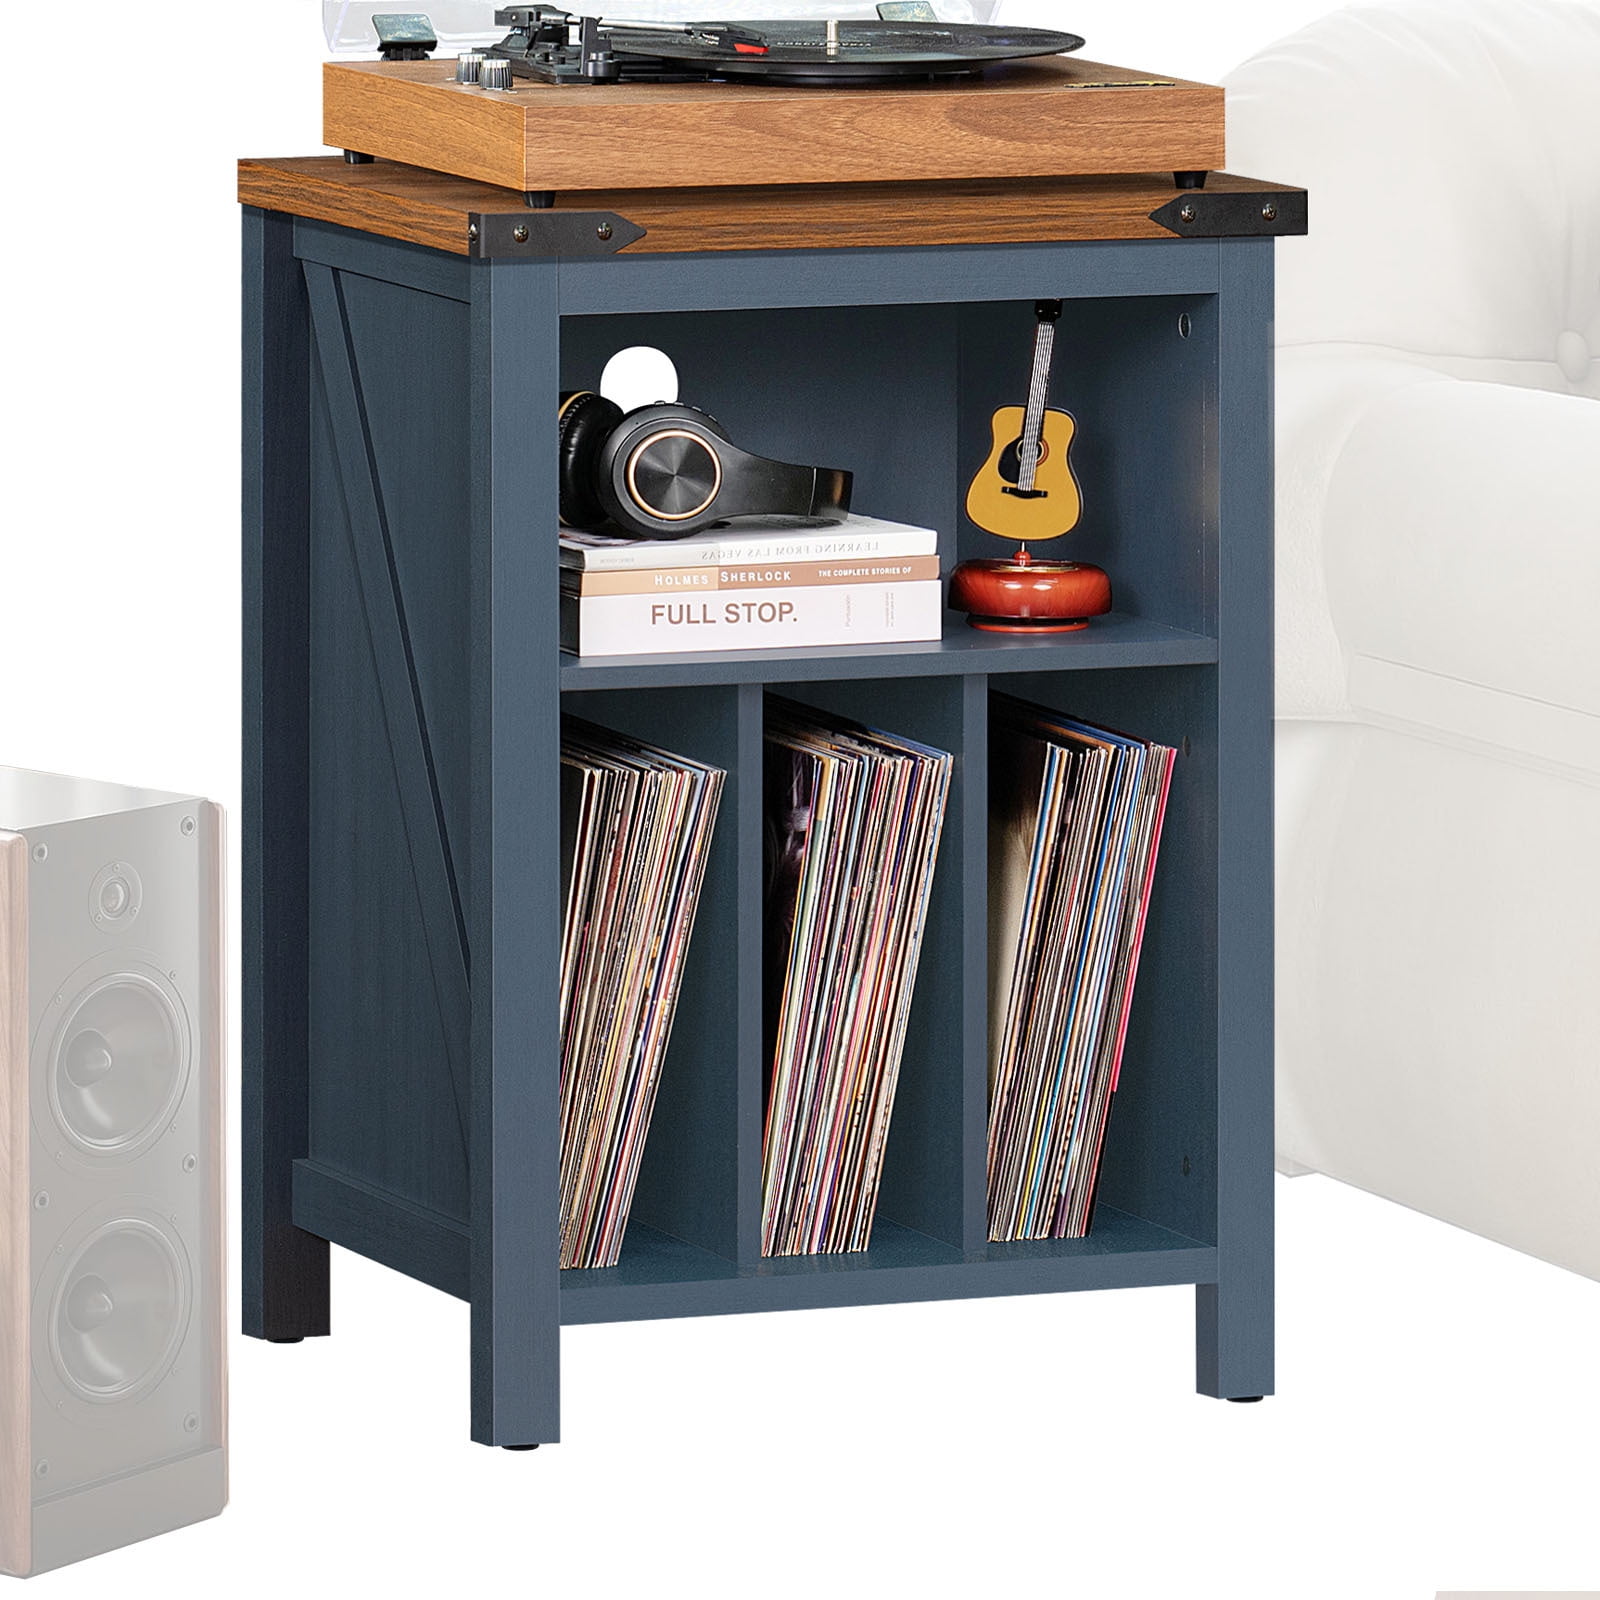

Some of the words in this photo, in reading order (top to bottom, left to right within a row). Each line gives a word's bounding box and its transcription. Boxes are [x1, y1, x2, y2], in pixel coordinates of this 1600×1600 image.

[655, 574, 709, 586] HOLMES
[720, 571, 792, 583] SHERLOCK
[818, 569, 832, 577] THE
[833, 568, 870, 577] COMPLETE
[871, 567, 900, 576] STORIES
[902, 566, 912, 574] OF
[651, 603, 717, 625] FULL
[724, 601, 798, 624] STOP.
